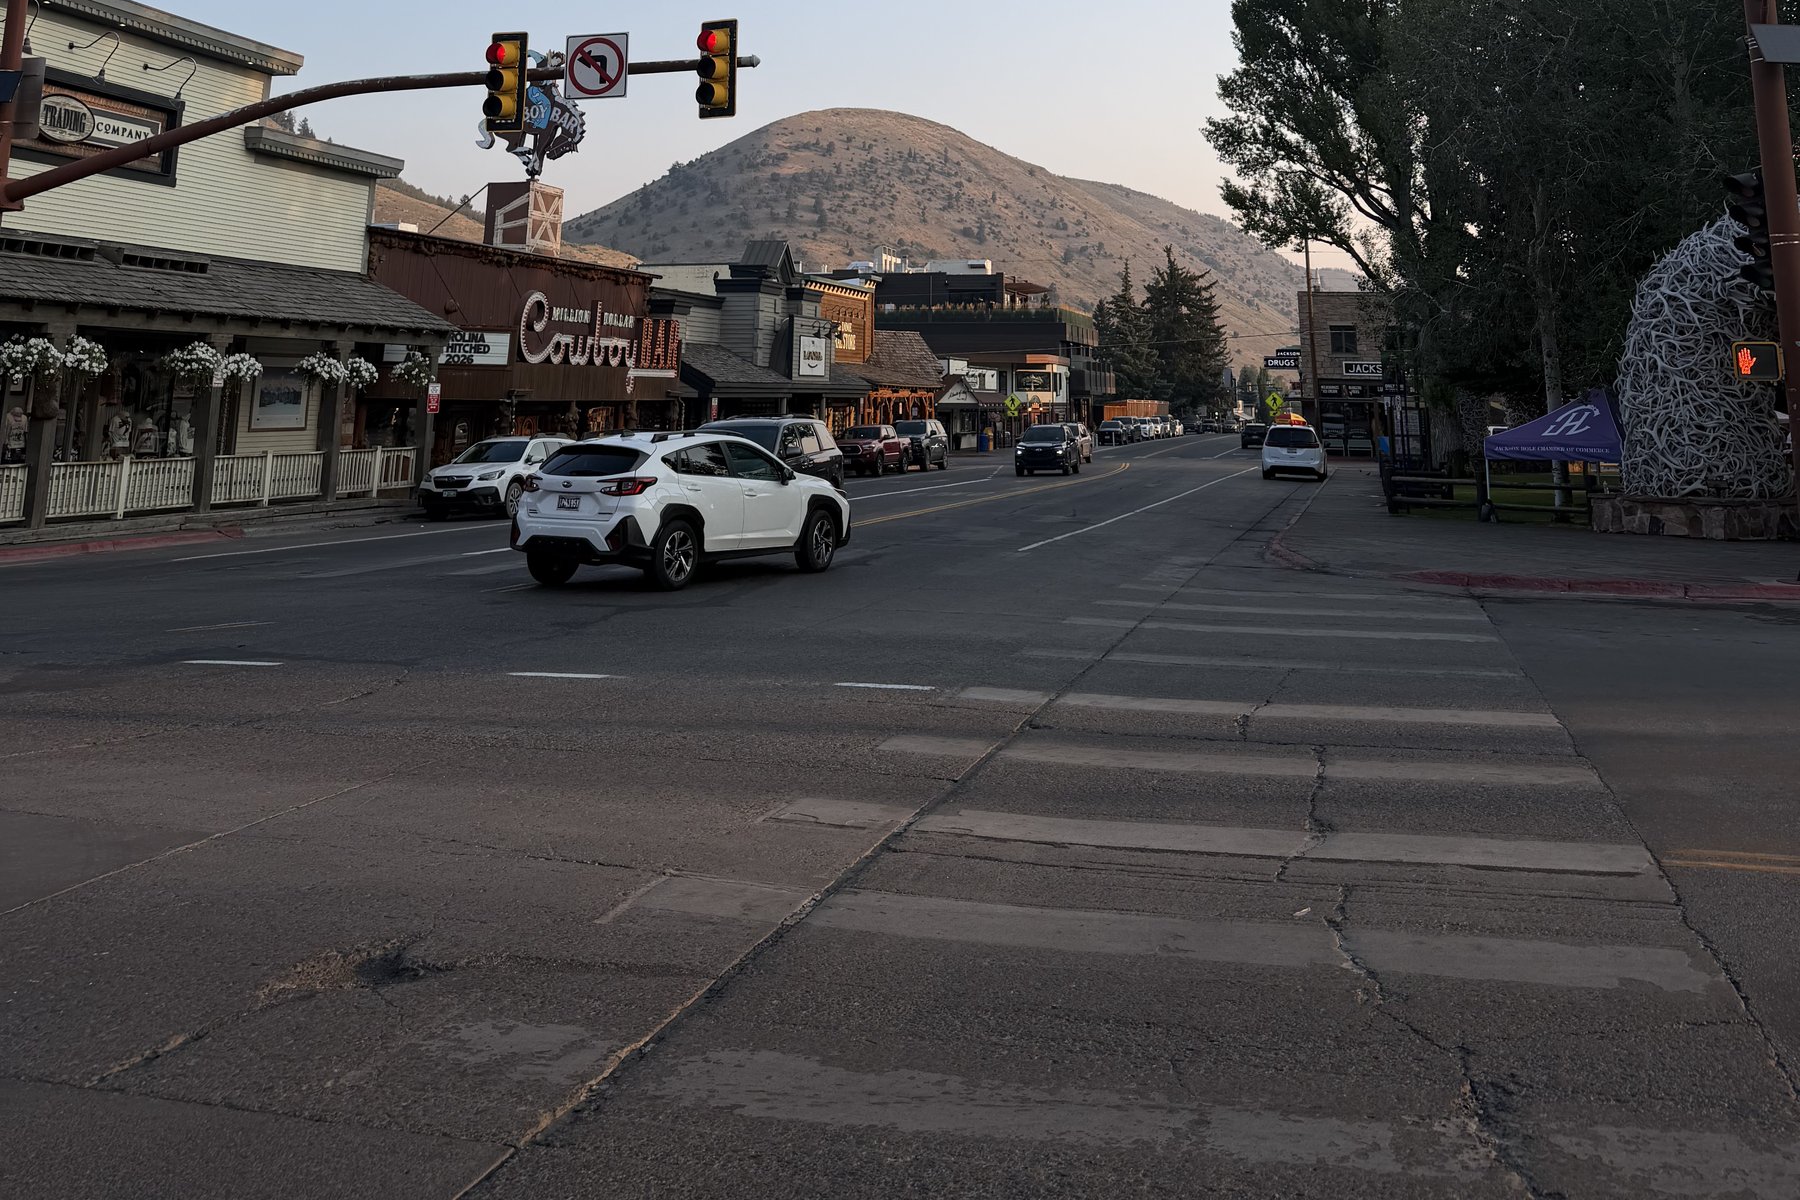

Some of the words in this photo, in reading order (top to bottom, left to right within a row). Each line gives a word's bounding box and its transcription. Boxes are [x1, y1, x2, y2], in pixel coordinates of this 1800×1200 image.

[43, 104, 87, 133] TRADING
[549, 106, 579, 134] BAR
[96, 122, 150, 140] COMPANY
[551, 306, 592, 324] MILLION
[603, 311, 636, 329] DOLLAR
[446, 344, 491, 354] HITCHED
[520, 290, 639, 394] Cowboy
[639, 316, 680, 369] BAR
[444, 354, 474, 364] 2026
[1267, 358, 1296, 367] DRUGS
